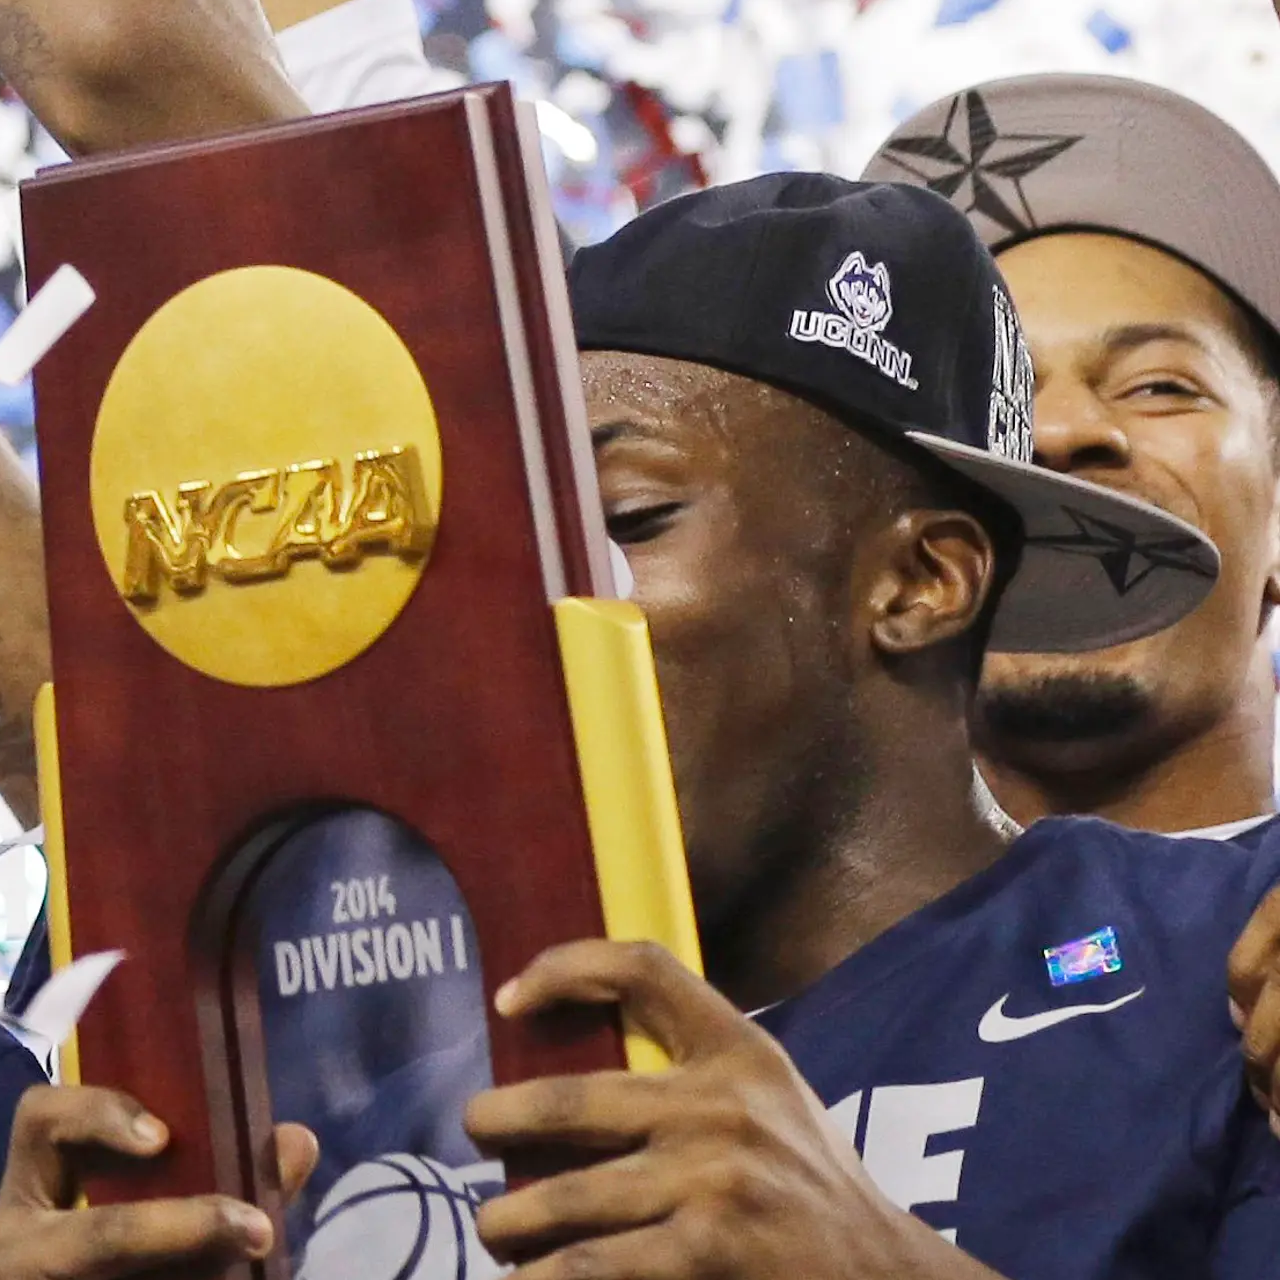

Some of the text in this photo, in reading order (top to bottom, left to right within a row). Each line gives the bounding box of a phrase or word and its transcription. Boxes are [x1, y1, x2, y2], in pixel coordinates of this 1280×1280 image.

[789, 309, 912, 382] UCONN
[124, 444, 430, 606] NCAA
[330, 876, 397, 923] 2014
[274, 914, 468, 997] DIVISION I
